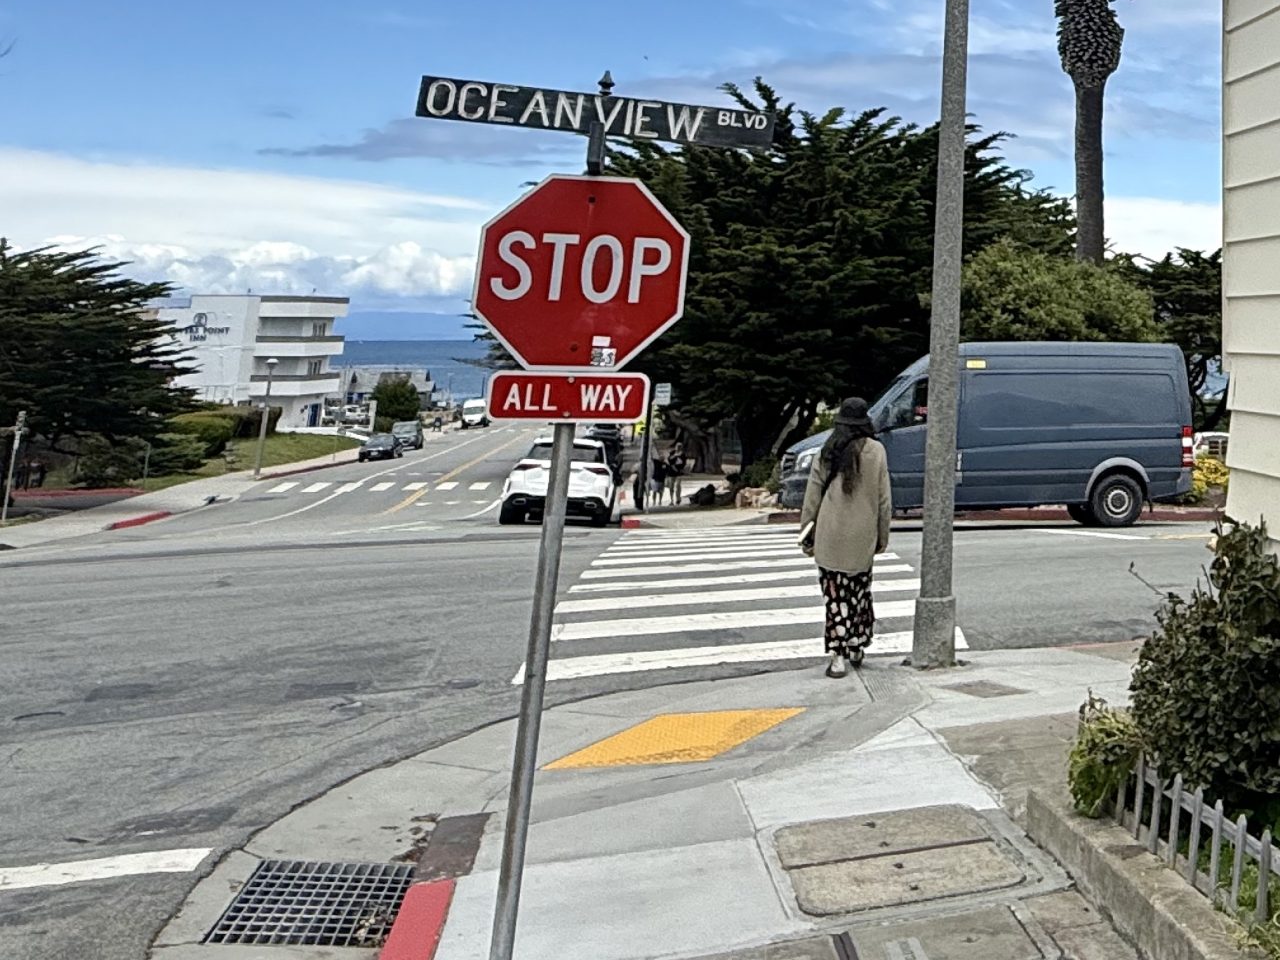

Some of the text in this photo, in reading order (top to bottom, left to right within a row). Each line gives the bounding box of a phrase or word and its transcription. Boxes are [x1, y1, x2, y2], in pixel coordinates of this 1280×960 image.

[426, 79, 768, 141] OCEAN VIEW BLVD
[490, 230, 672, 304] STOP
[503, 382, 557, 411] ALL
[580, 383, 633, 412] WAY
